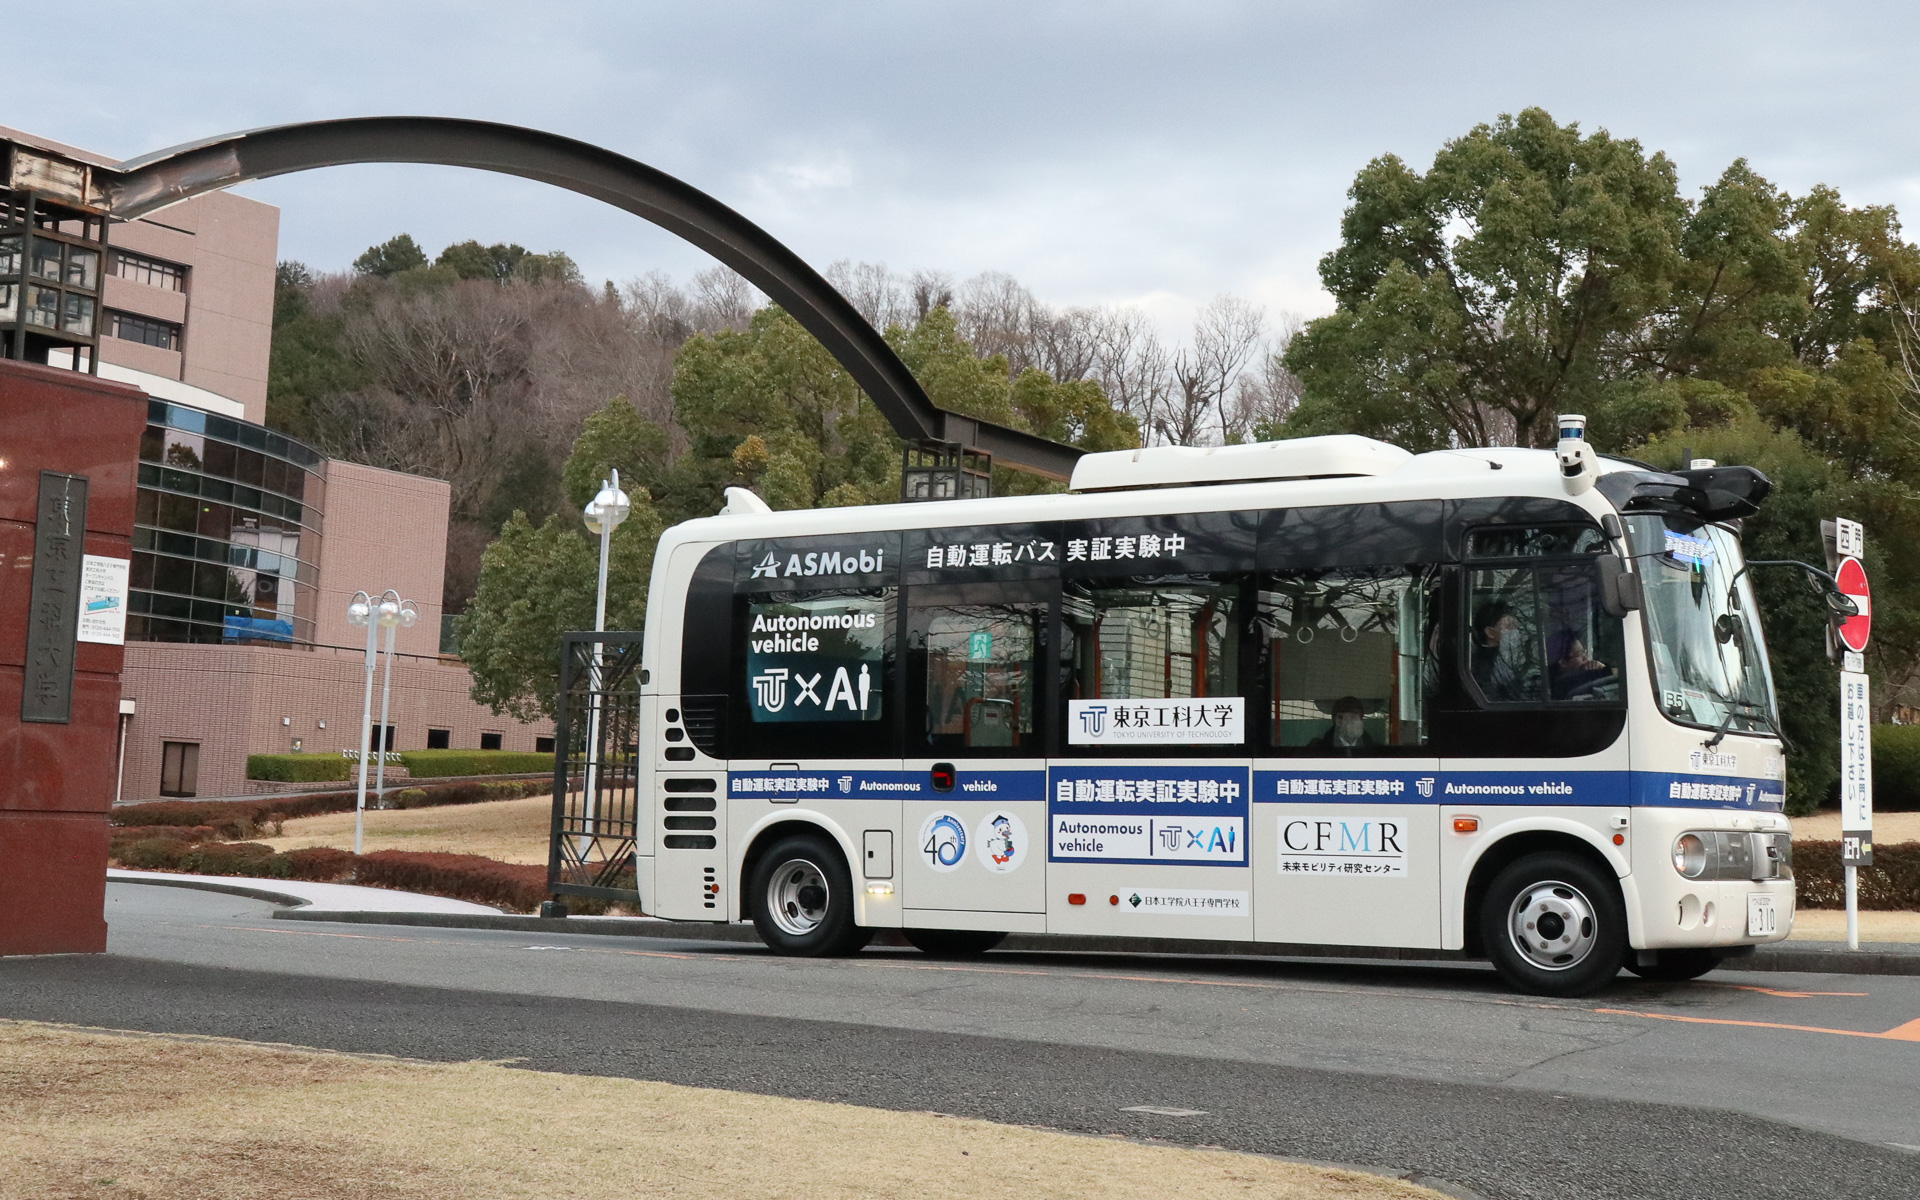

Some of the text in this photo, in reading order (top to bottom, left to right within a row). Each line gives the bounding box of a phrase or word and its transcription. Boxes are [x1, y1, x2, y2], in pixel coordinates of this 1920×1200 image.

[926, 533, 1186, 568] 自動運転バス 実証実験中
[784, 548, 884, 577] ASMobi
[752, 613, 876, 632] Autonomous
[752, 632, 819, 653] vehicle
[1113, 704, 1233, 728] 東京工科大学
[1702, 753, 1737, 769] 東京工科大学
[732, 777, 829, 792] 自動運転実証実験中
[859, 780, 921, 792] Autonomous
[963, 780, 997, 792] vehicle
[1056, 779, 1240, 804] 自動運転実証実験中
[1276, 778, 1405, 796] 自動運転実証実験中
[1445, 782, 1525, 795] Autonomous
[1529, 782, 1573, 795] vehicle
[1669, 781, 1742, 802] 自動運転実証実験中
[947, 817, 965, 845] Anniversary
[1058, 821, 1143, 835] Autonomous
[1283, 820, 1404, 853] CFMR
[1059, 838, 1104, 852] vehicle
[1282, 862, 1401, 874] 未来モビリティ研究センター
[1145, 896, 1240, 909] 日本工学院八王子専門学校
